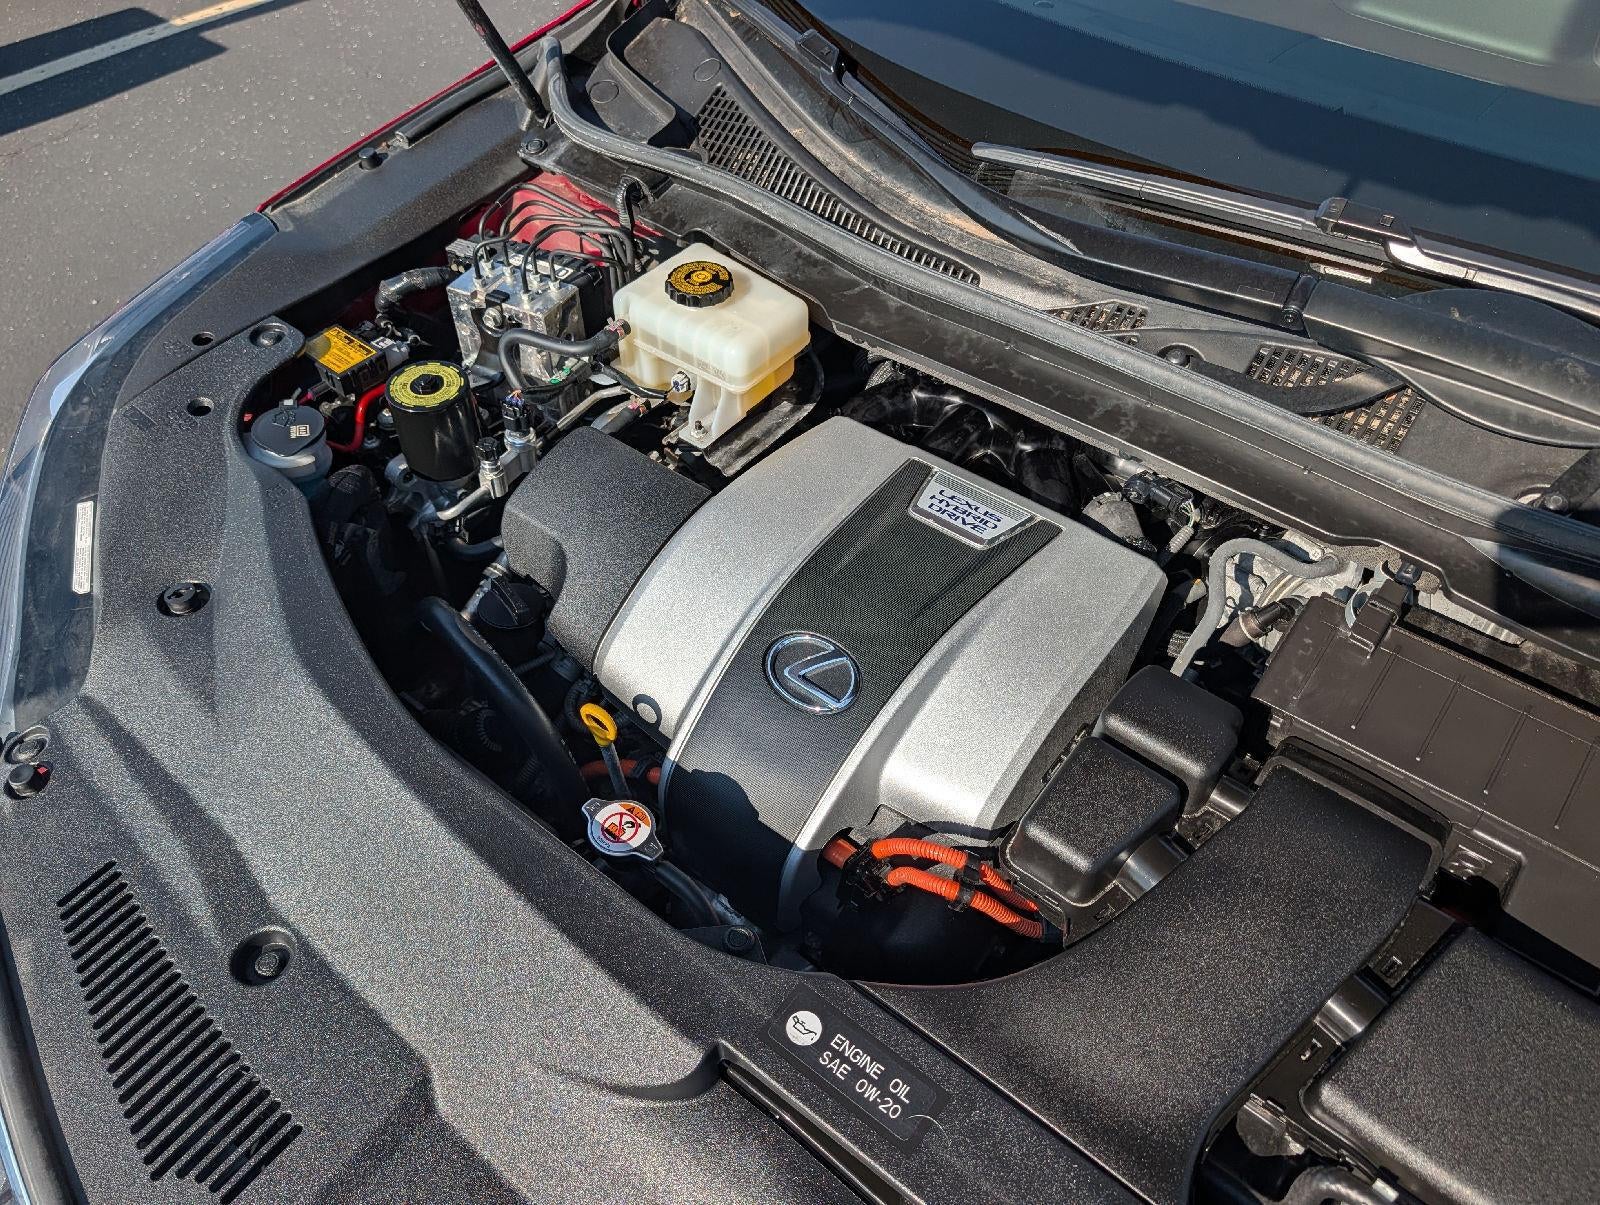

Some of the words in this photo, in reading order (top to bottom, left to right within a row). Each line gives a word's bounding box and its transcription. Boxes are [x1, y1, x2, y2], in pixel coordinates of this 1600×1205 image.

[928, 503, 988, 535] DRIVE
[929, 495, 998, 530] HYBRID
[938, 489, 1003, 523] LEXUS
[819, 1051, 851, 1080] SAE
[830, 1033, 885, 1080] ENGINE
[889, 1078, 911, 1104] OIL
